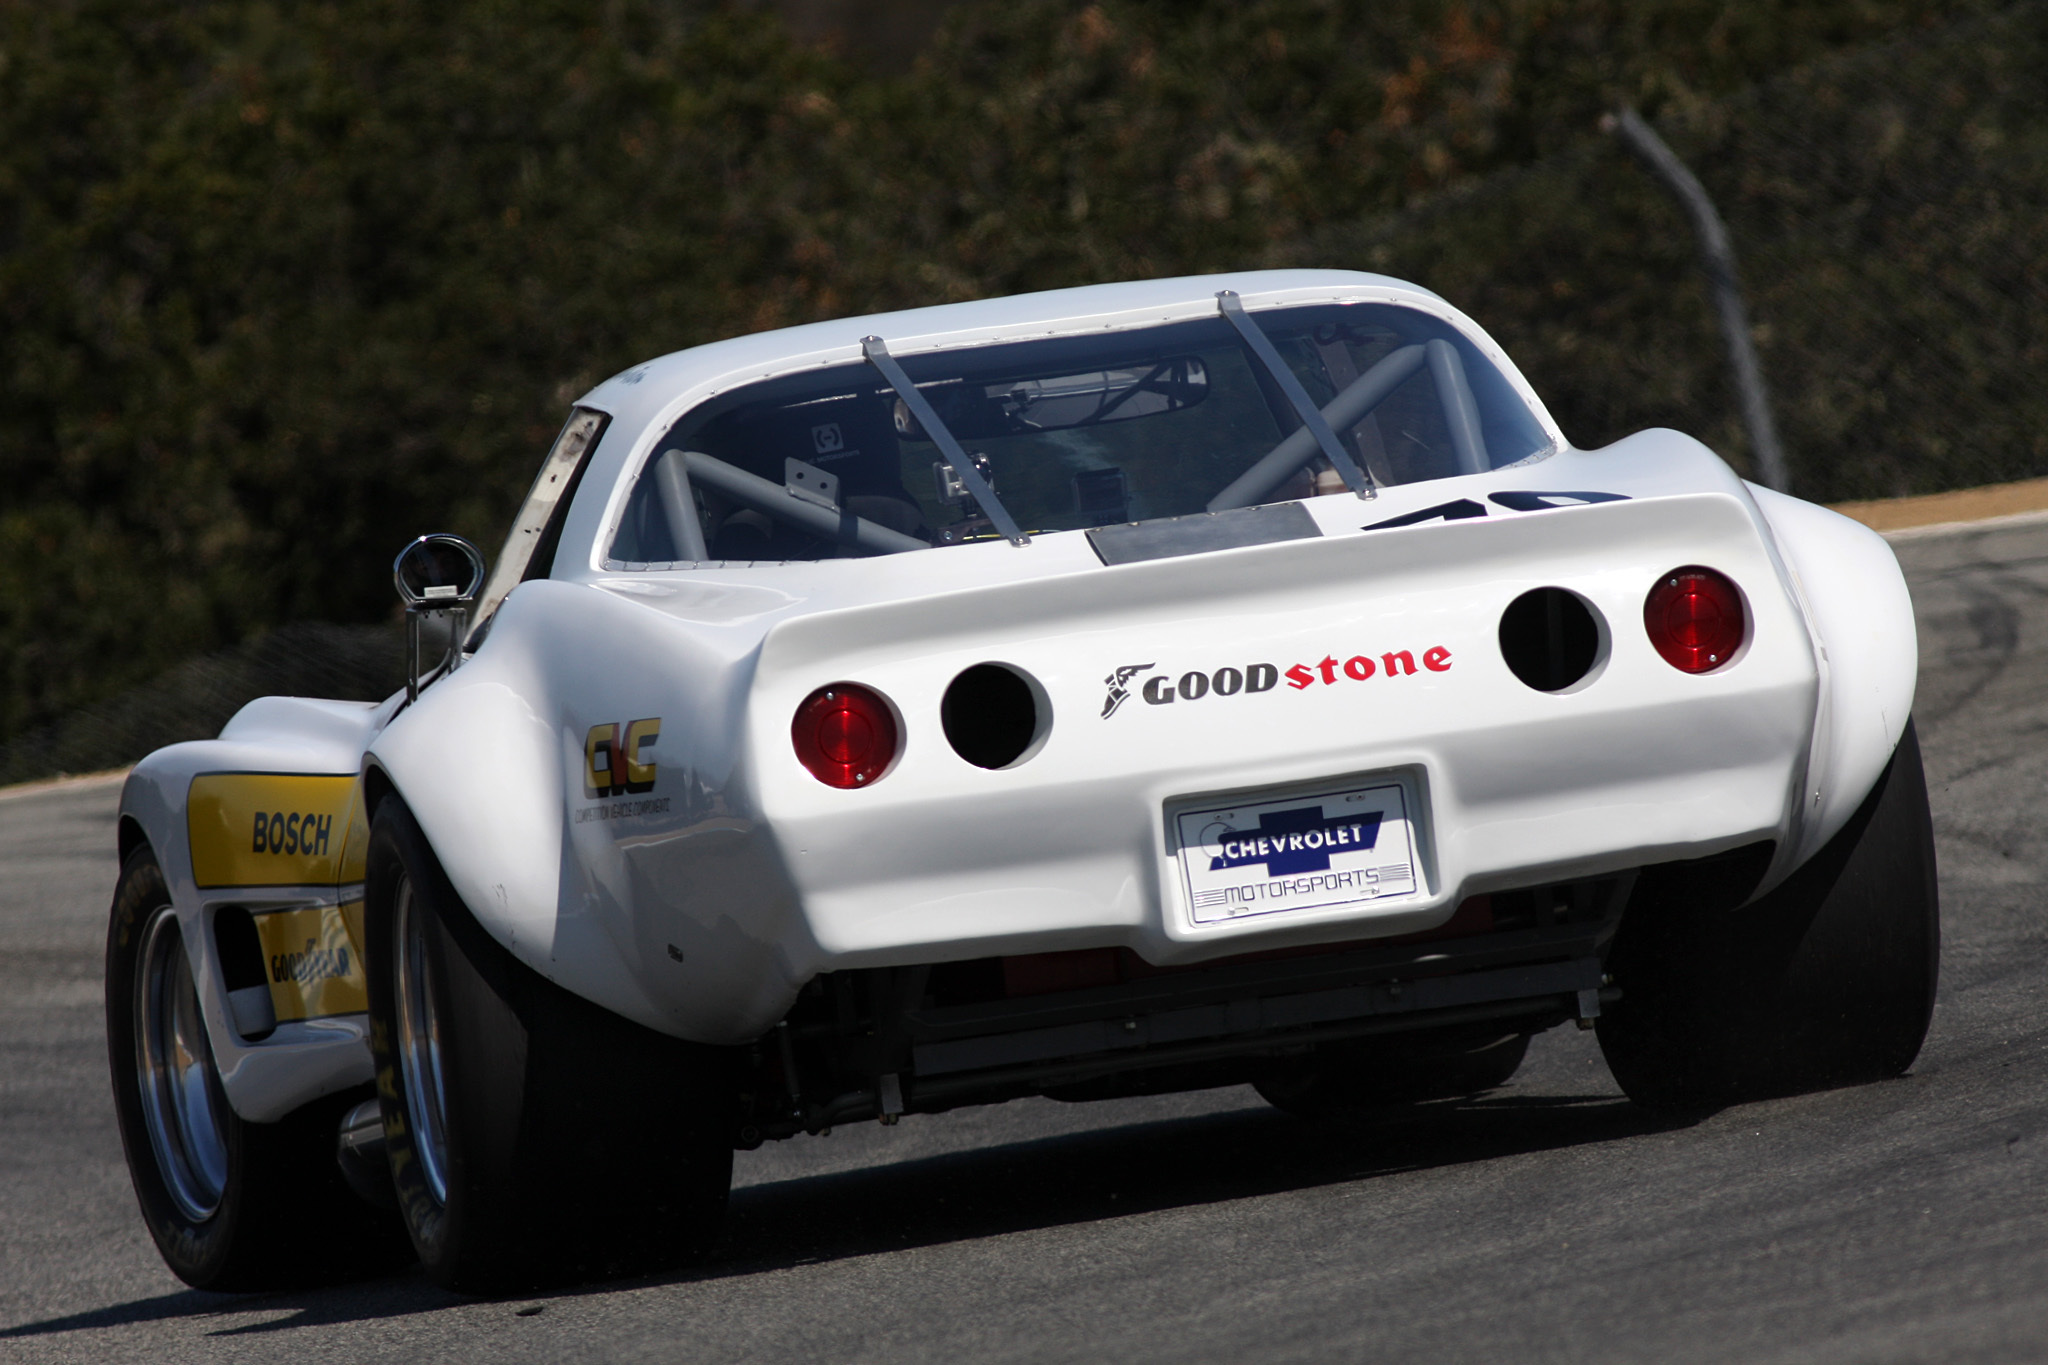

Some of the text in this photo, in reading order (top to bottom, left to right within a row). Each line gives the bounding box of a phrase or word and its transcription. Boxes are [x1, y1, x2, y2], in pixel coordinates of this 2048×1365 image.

[252, 811, 332, 856] BOSCH
[1224, 823, 1362, 859] CHEVROLET
[1224, 867, 1379, 903] MOTORSPORTS
